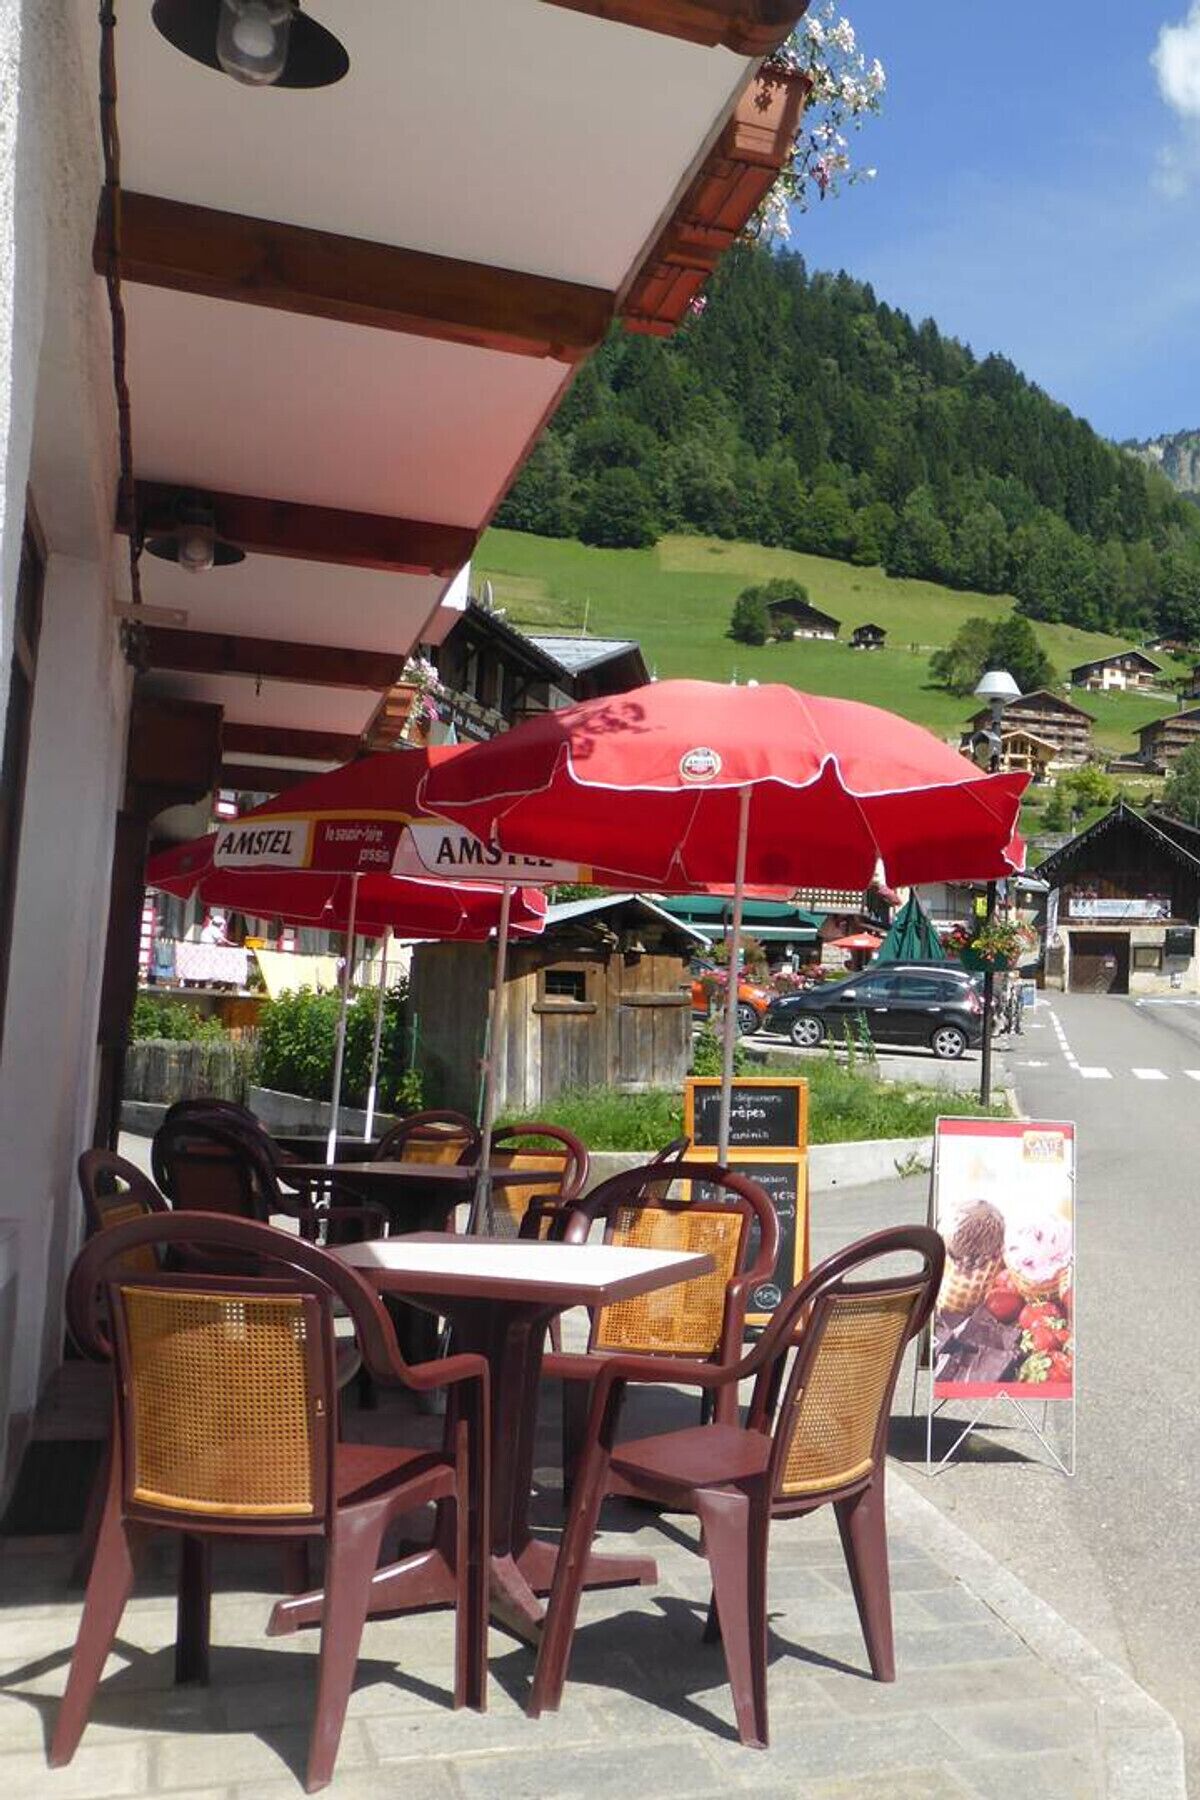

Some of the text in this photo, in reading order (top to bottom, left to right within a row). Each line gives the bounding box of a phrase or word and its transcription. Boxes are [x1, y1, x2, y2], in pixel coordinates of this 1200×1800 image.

[218, 829, 294, 856] AMSTEL
[436, 836, 553, 867] AMS
[730, 1104, 767, 1121] rêpes
